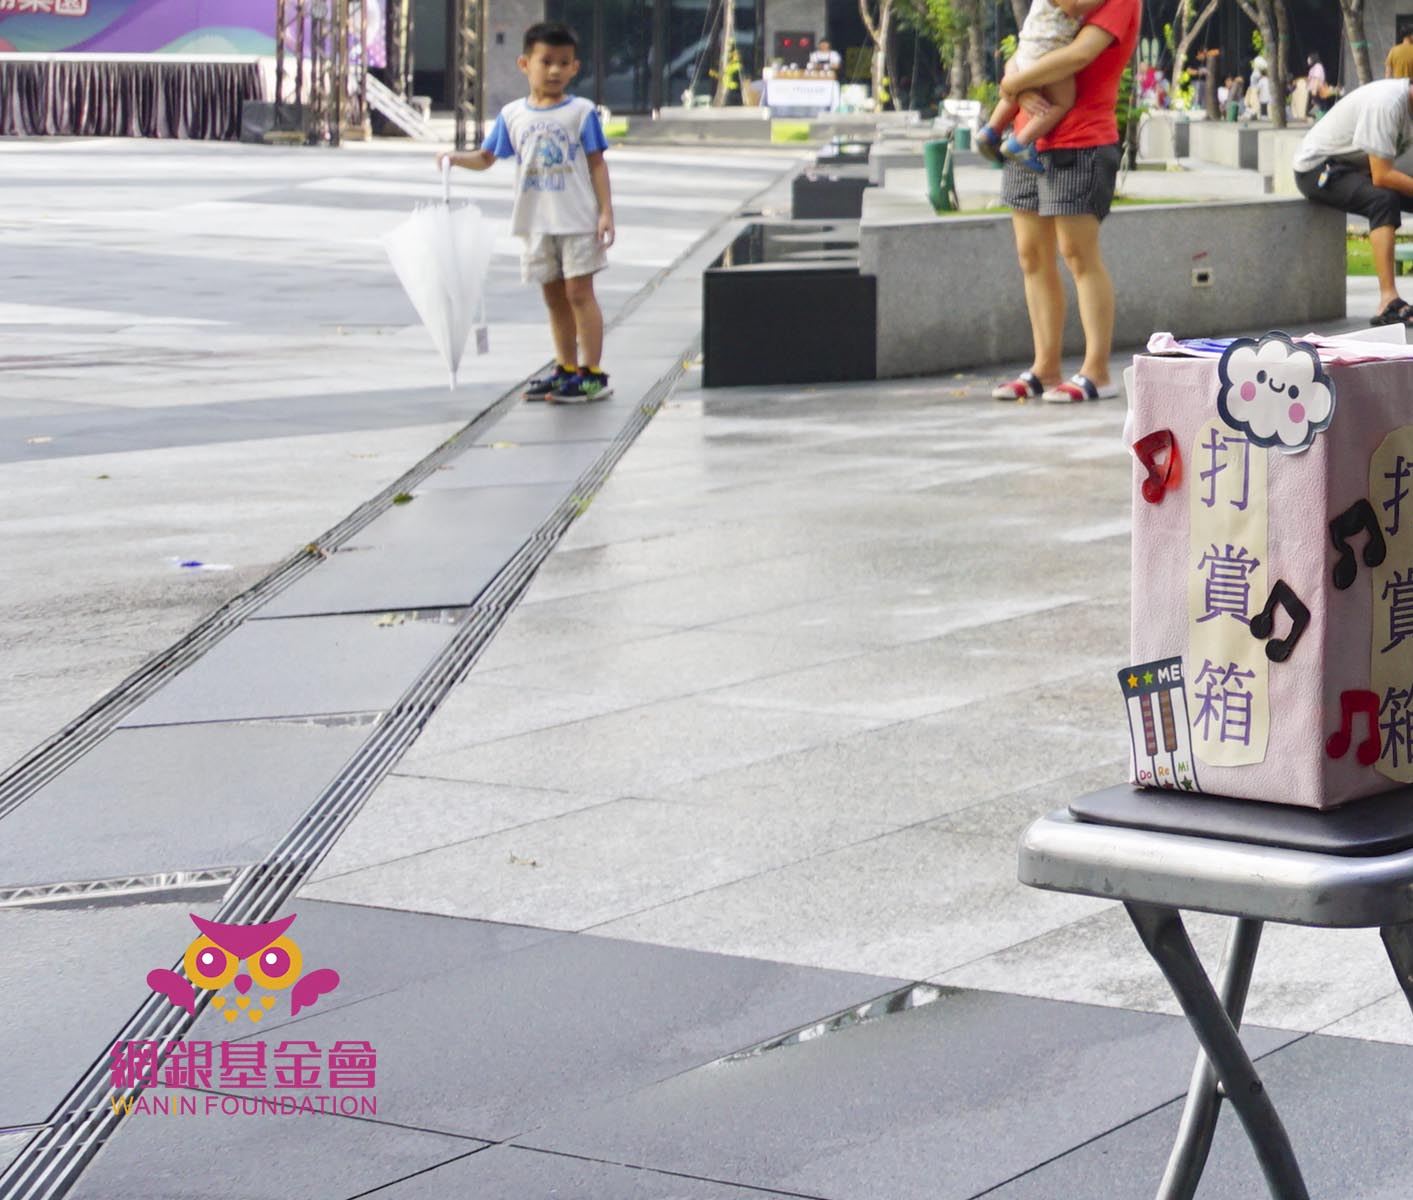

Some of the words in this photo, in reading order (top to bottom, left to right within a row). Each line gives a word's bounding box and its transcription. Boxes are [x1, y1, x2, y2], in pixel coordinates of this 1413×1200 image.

[1192, 427, 1261, 747] 打賞箱
[1157, 664, 1184, 684] ME
[1139, 770, 1152, 781] Do
